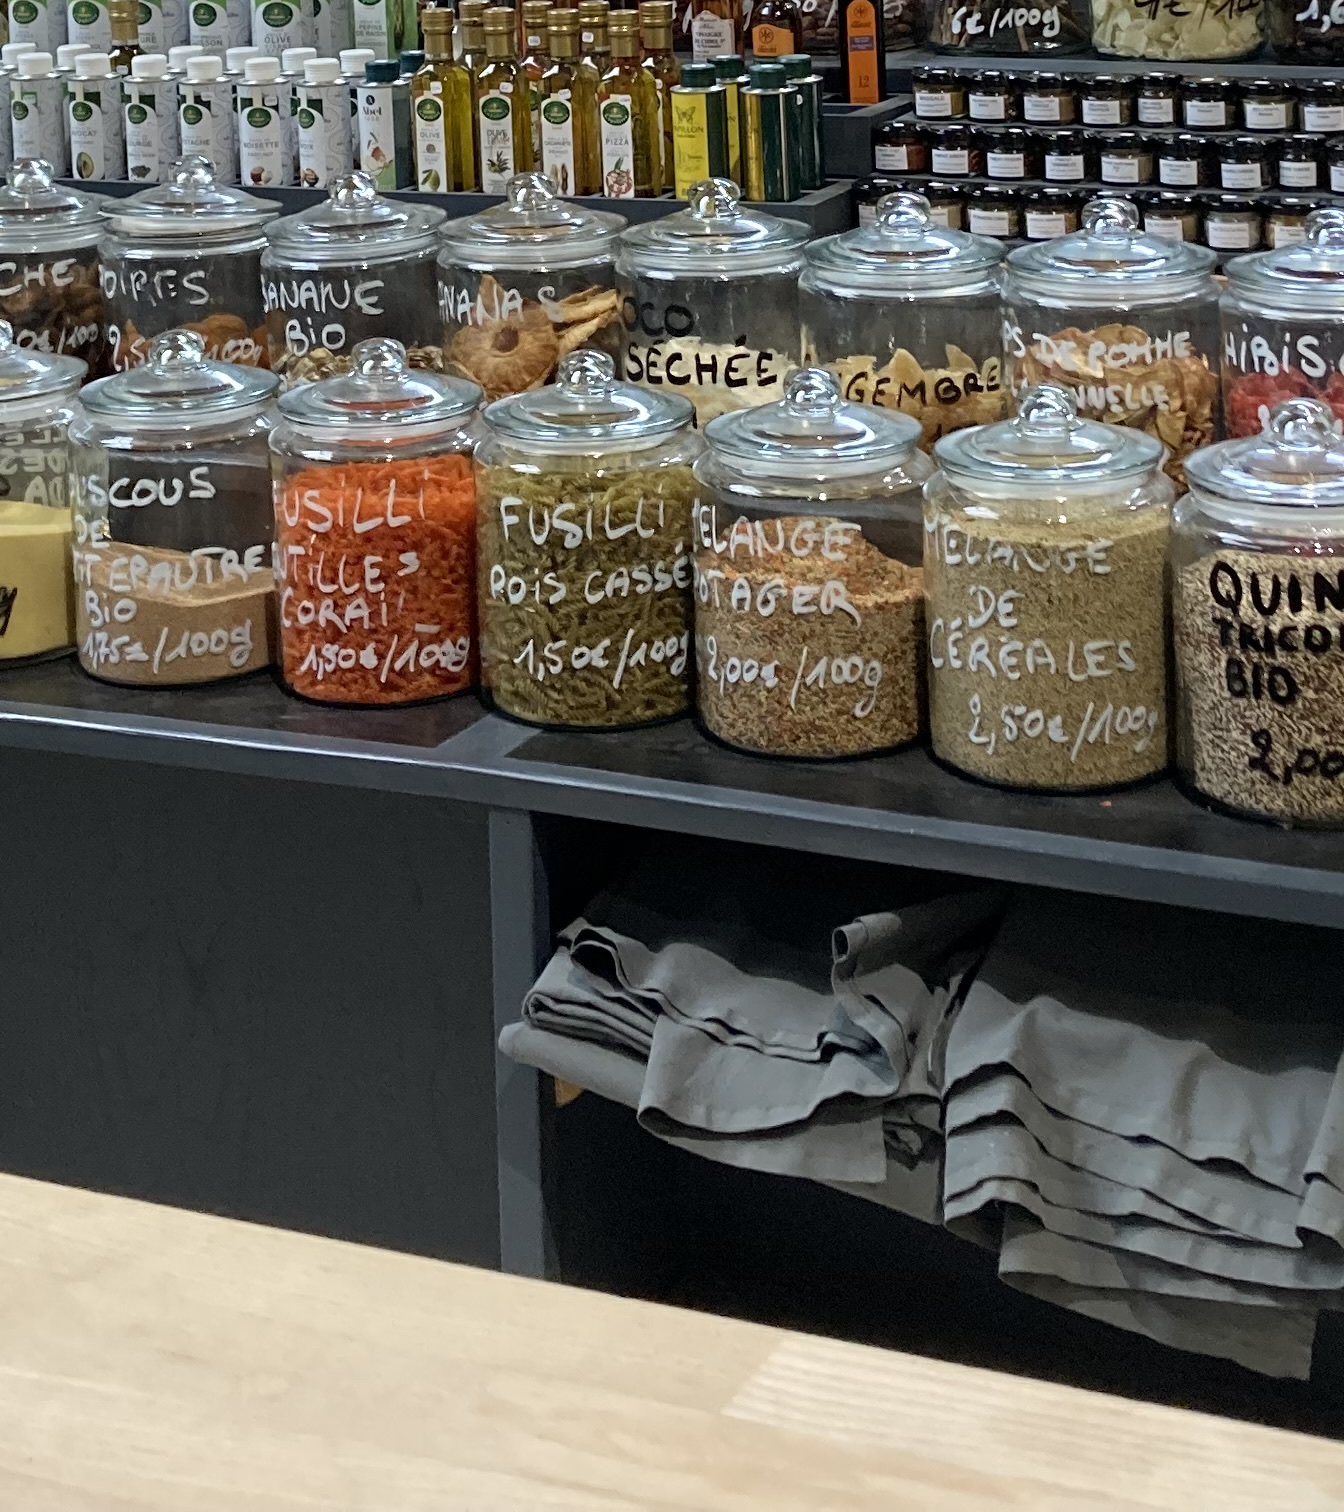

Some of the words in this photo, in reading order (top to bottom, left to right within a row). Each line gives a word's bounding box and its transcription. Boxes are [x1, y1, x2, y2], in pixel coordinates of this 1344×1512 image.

[858, 74, 870, 88] 12
[605, 138, 629, 146] PIZZA
[967, 585, 1026, 630] DE
[1225, 657, 1297, 705] BIO
